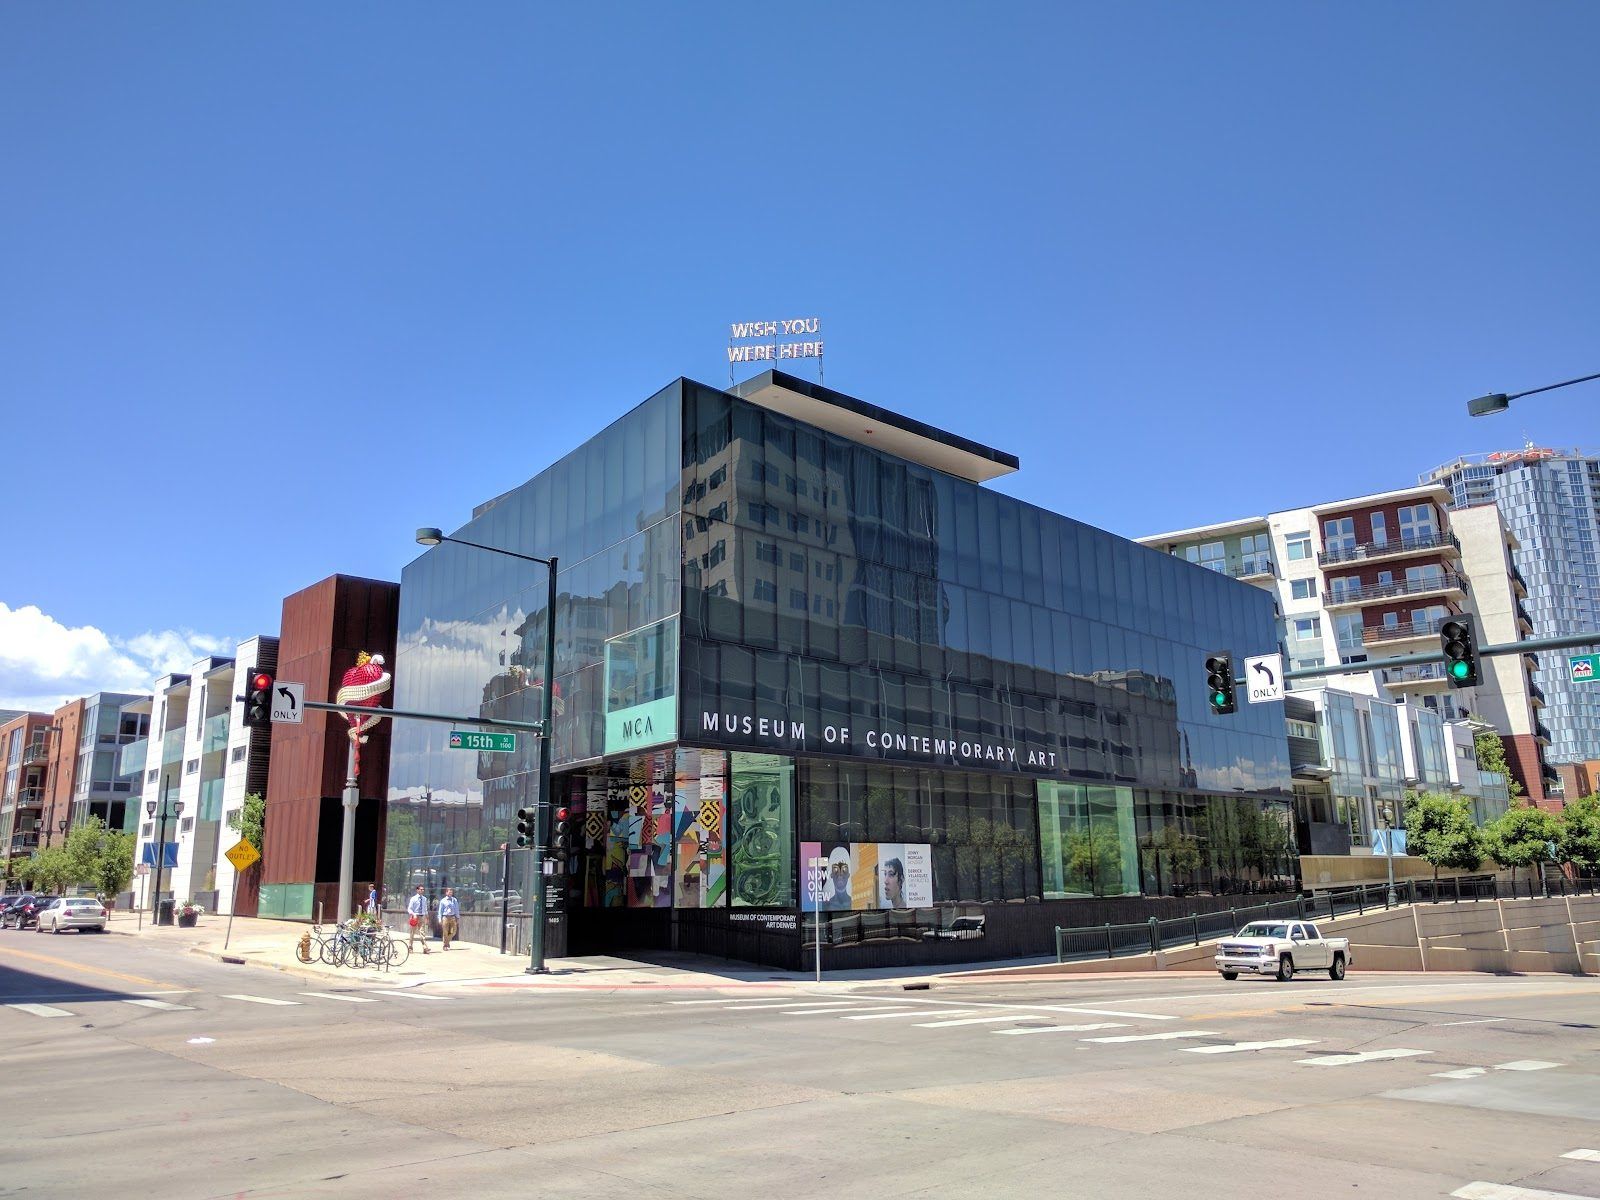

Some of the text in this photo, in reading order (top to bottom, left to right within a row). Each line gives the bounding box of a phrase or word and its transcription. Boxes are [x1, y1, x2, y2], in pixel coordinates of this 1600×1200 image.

[732, 317, 818, 338] WISH YOU
[728, 341, 824, 362] WERE HERE
[1253, 687, 1278, 699] ONLY
[273, 710, 298, 720] ONLY
[623, 716, 653, 738] MCA
[467, 735, 493, 748] 15th
[703, 711, 1056, 767] MUSEUM OF CONTEMPORARY ART
[229, 852, 255, 861] OUTLET
[807, 870, 831, 881] NOW
[807, 880, 823, 892] ON
[730, 913, 796, 922] MUSEUM OF CONTEMPORARY
[766, 921, 796, 930] ART DENVER
